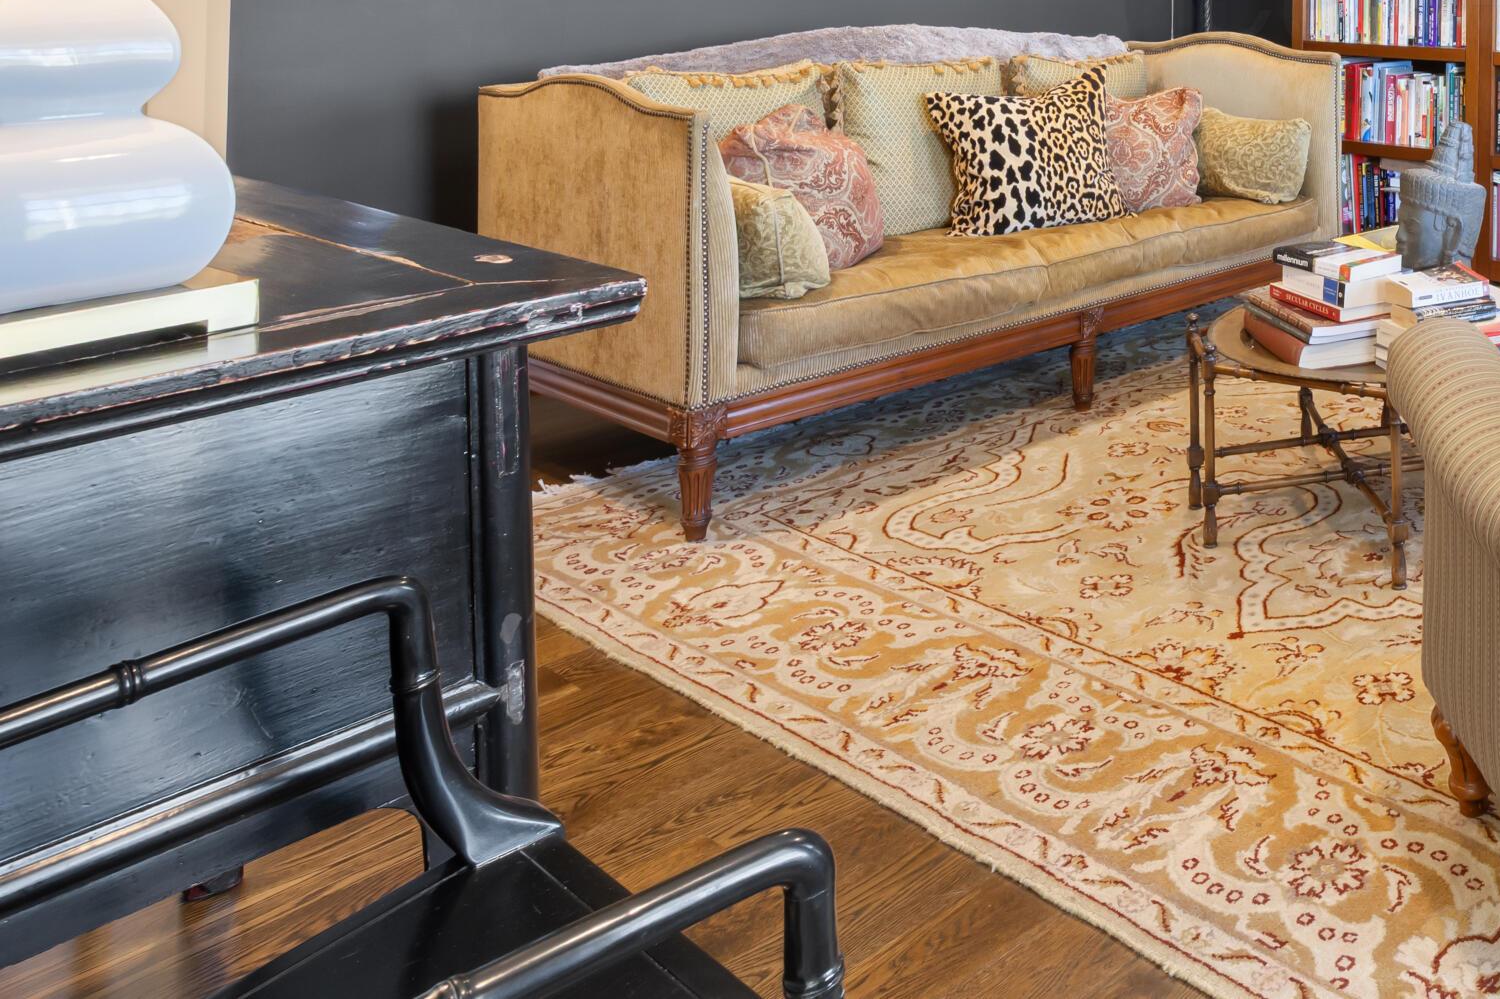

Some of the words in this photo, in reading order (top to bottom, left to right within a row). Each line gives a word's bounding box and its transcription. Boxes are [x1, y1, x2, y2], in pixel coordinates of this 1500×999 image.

[1276, 253, 1309, 267] millennium
[1436, 285, 1480, 302] IVANHOE
[1285, 293, 1308, 308] SECULAR
[1308, 301, 1329, 315] CYCLES
